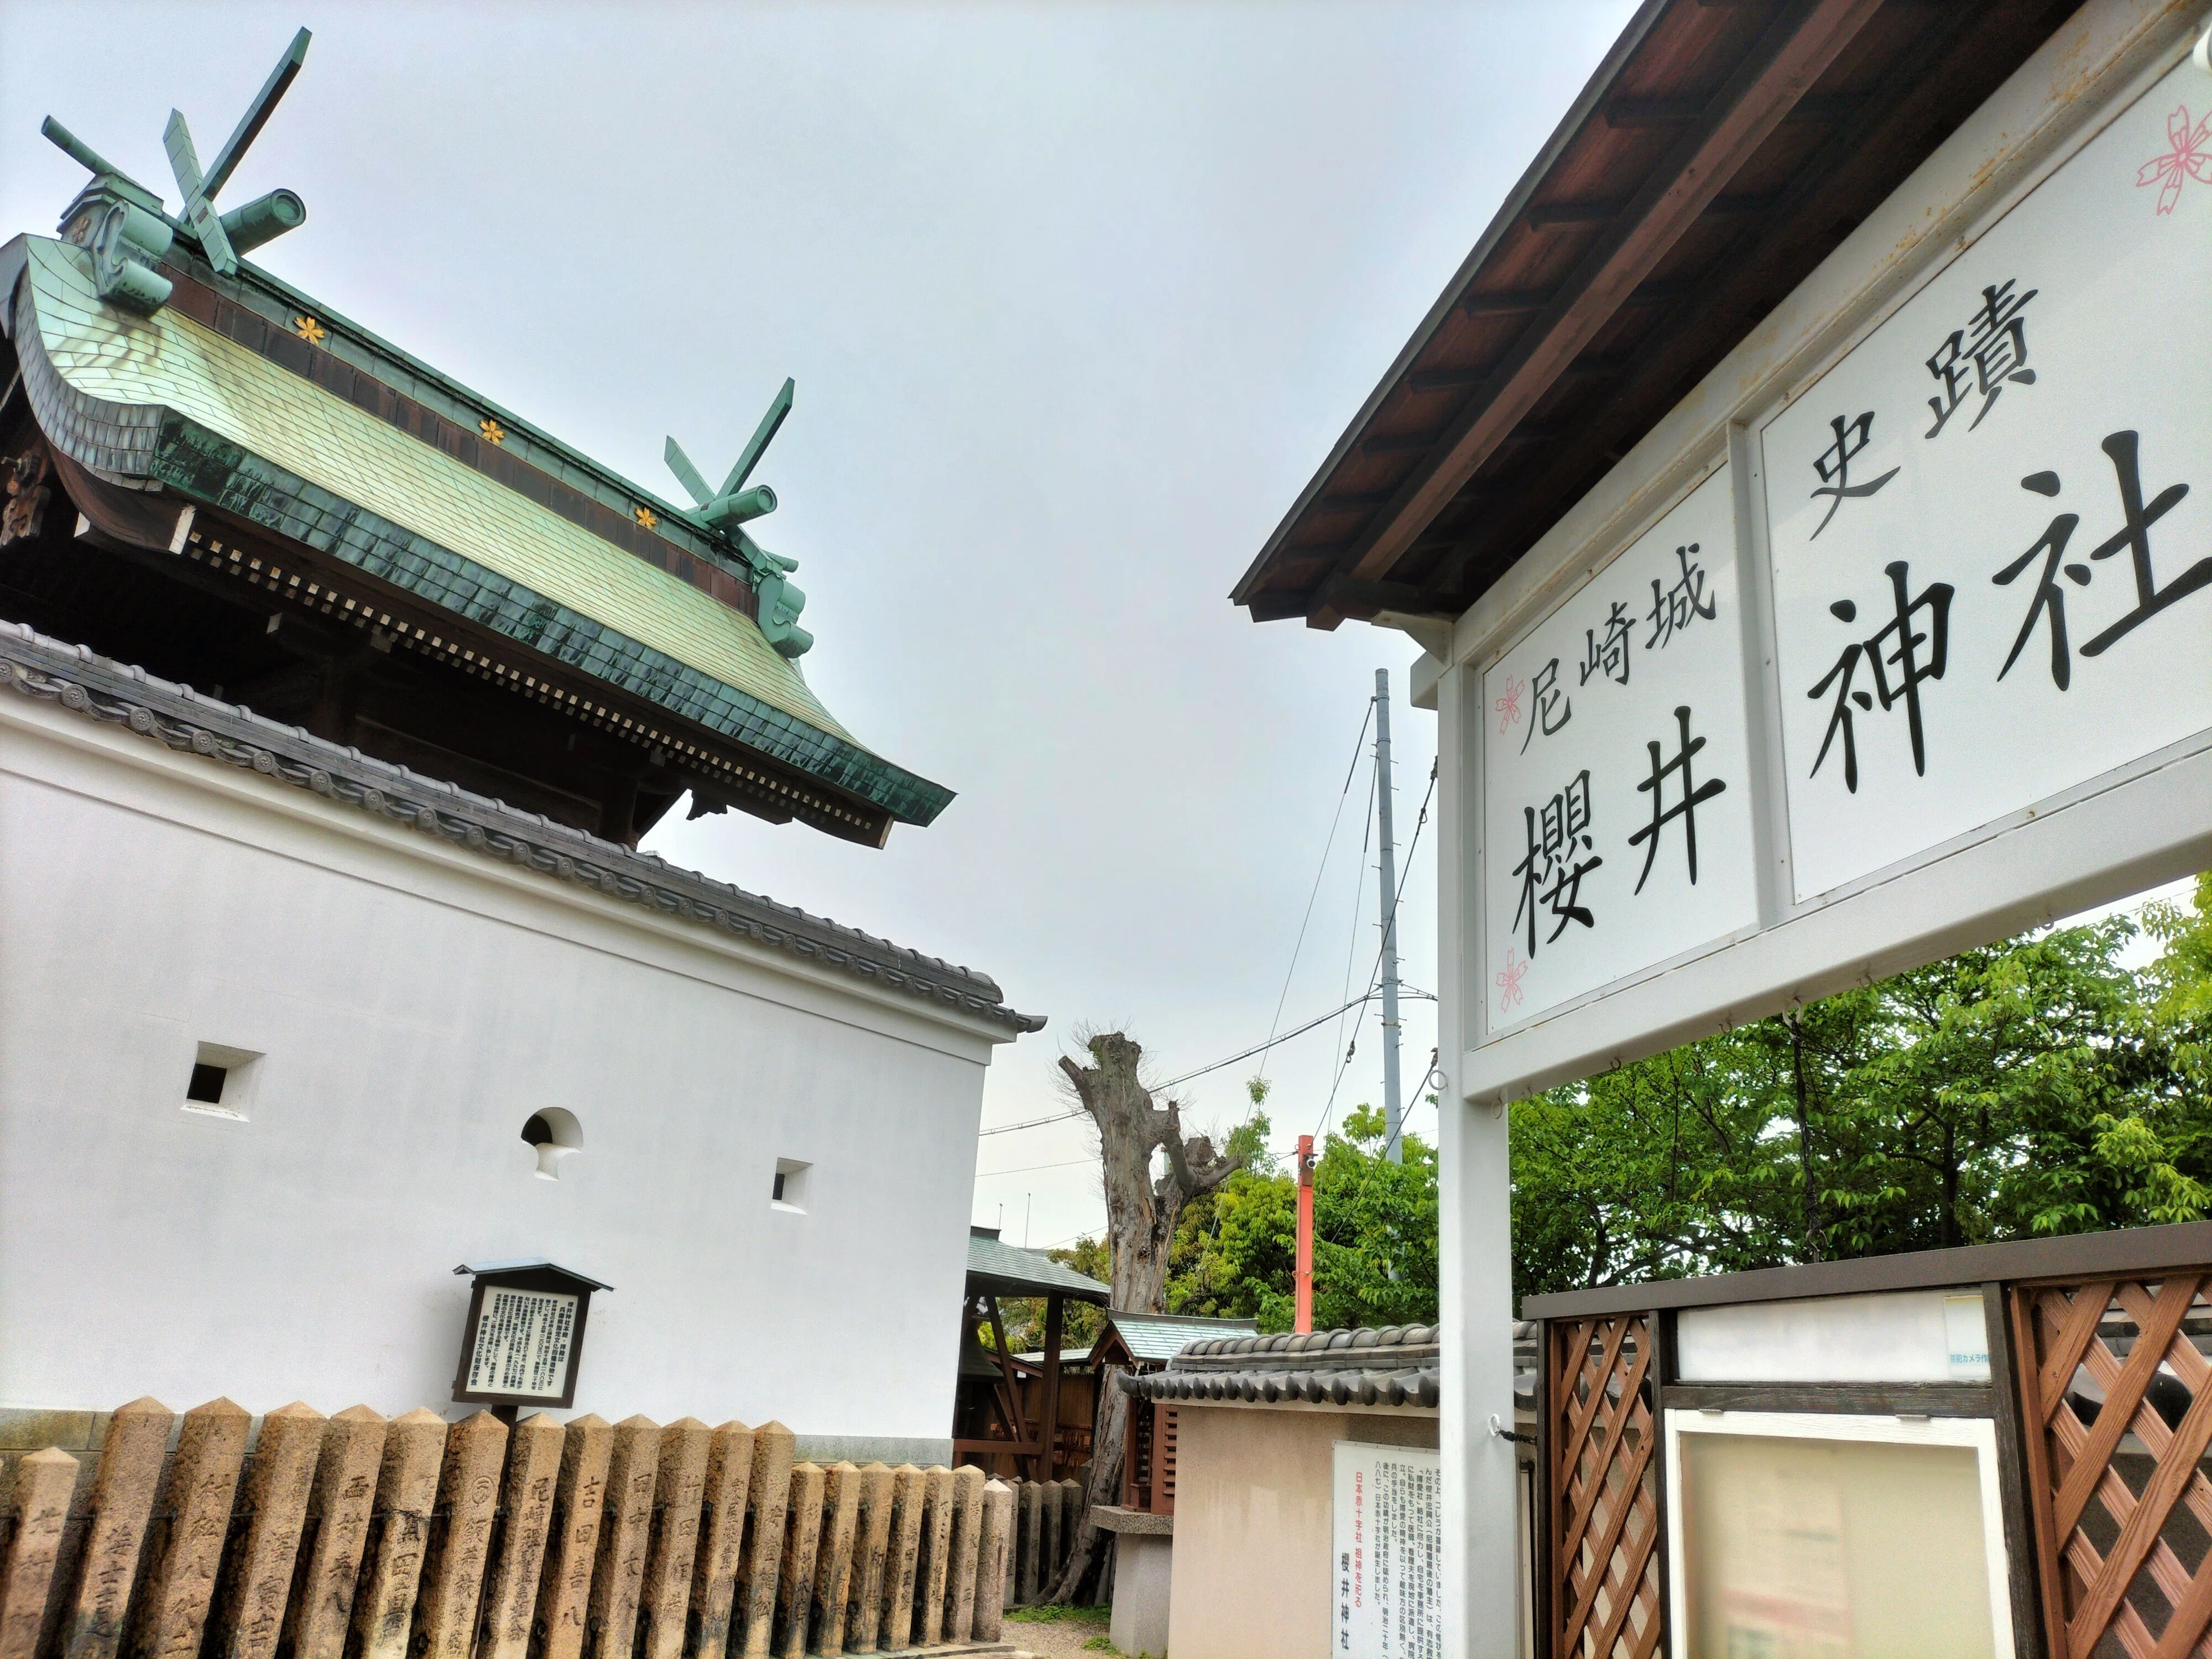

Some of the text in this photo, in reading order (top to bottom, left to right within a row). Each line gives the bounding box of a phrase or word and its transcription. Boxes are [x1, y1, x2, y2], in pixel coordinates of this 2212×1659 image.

[1512, 430, 2212, 959] 櫻井 神社
[1520, 279, 2039, 756] 尼崎城 史蹟
[1341, 1552, 1349, 1650] 櫻井神社
